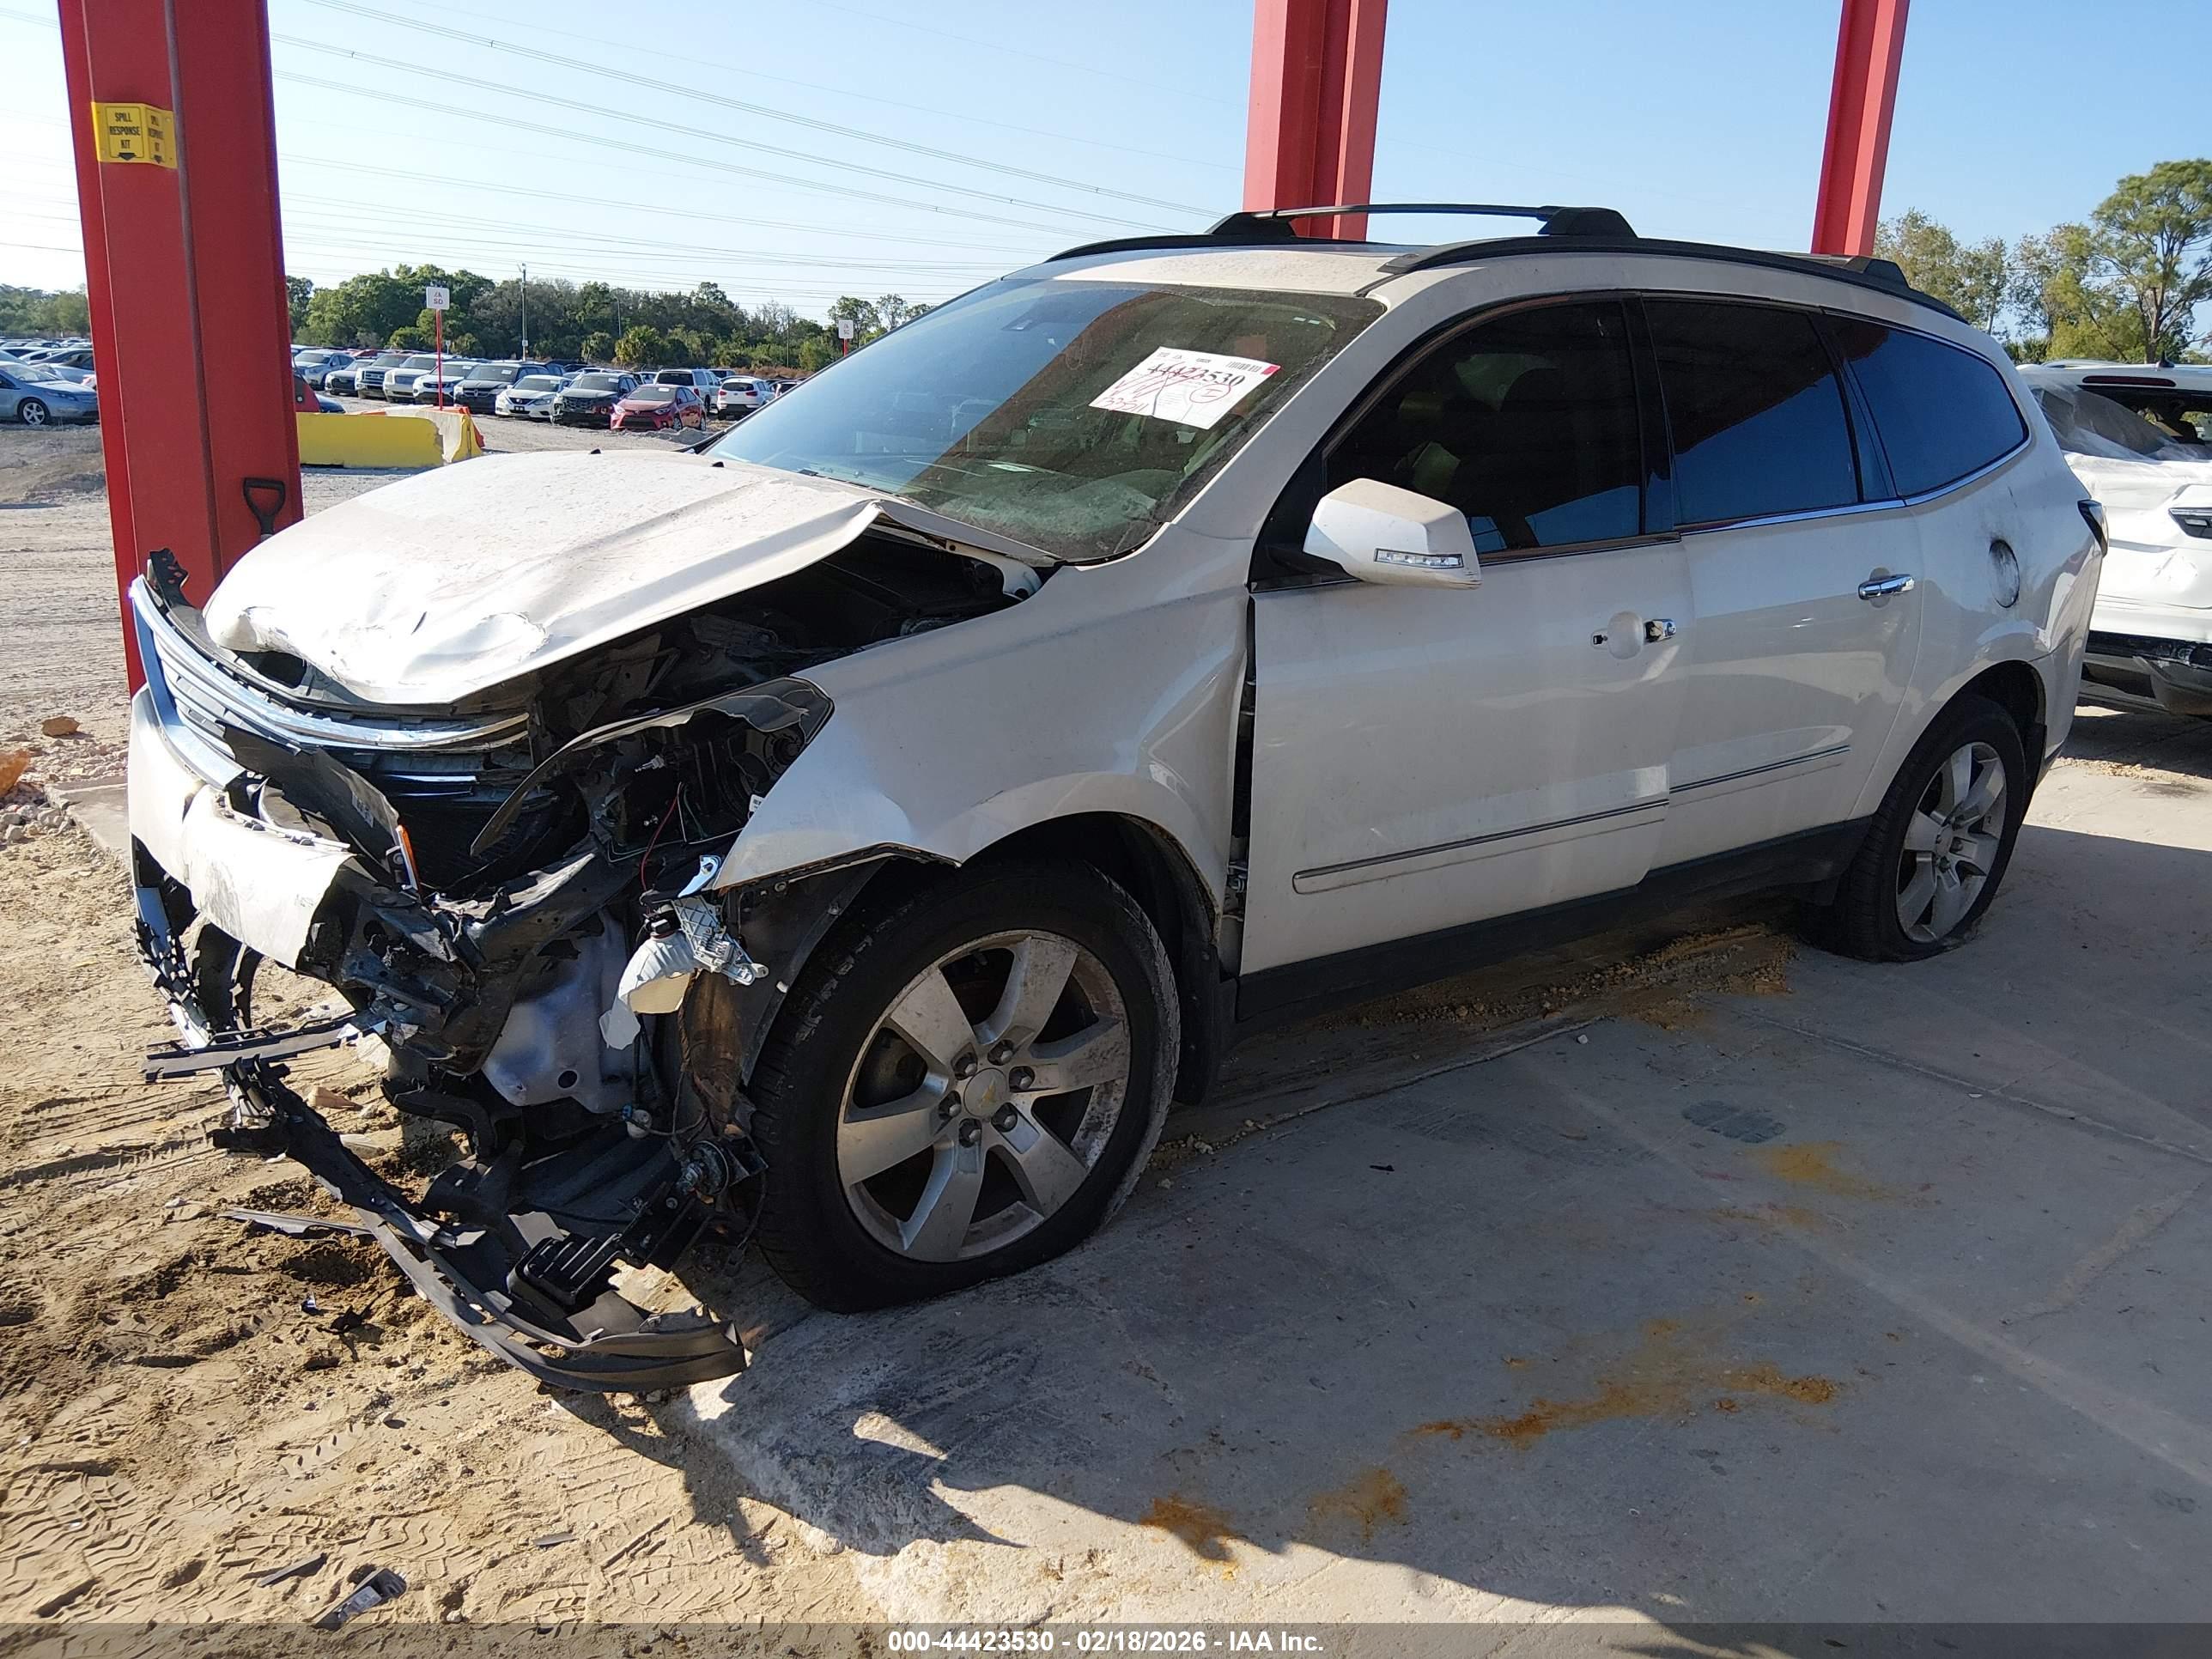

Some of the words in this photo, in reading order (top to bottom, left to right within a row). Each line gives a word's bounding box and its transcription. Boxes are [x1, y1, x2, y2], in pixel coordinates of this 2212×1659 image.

[115, 112, 132, 122] SPILL
[109, 125, 140, 136] RESPONSE
[120, 139, 131, 149] KIT
